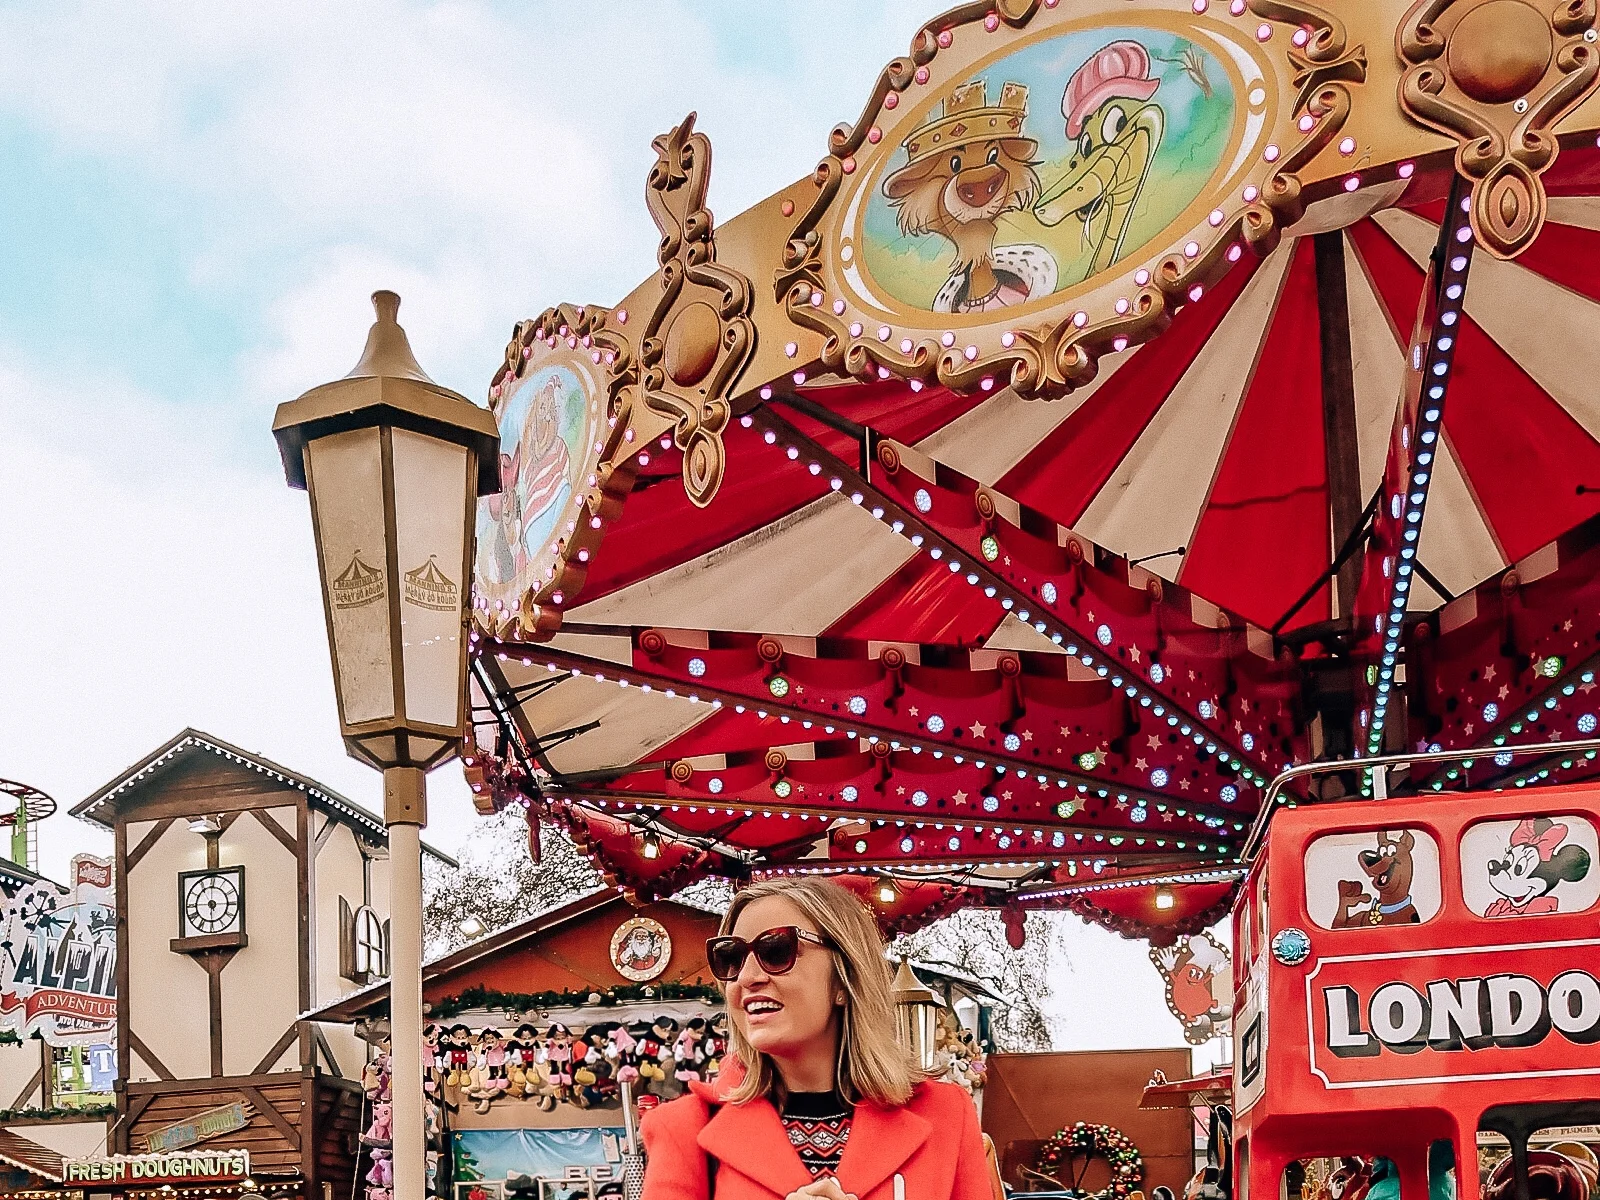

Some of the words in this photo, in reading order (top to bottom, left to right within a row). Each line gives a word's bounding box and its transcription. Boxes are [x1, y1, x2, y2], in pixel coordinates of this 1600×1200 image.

[1323, 970, 1600, 1058] LONDO
[69, 1160, 125, 1181] FRESH
[131, 1157, 244, 1178] DOUGHNUTS
